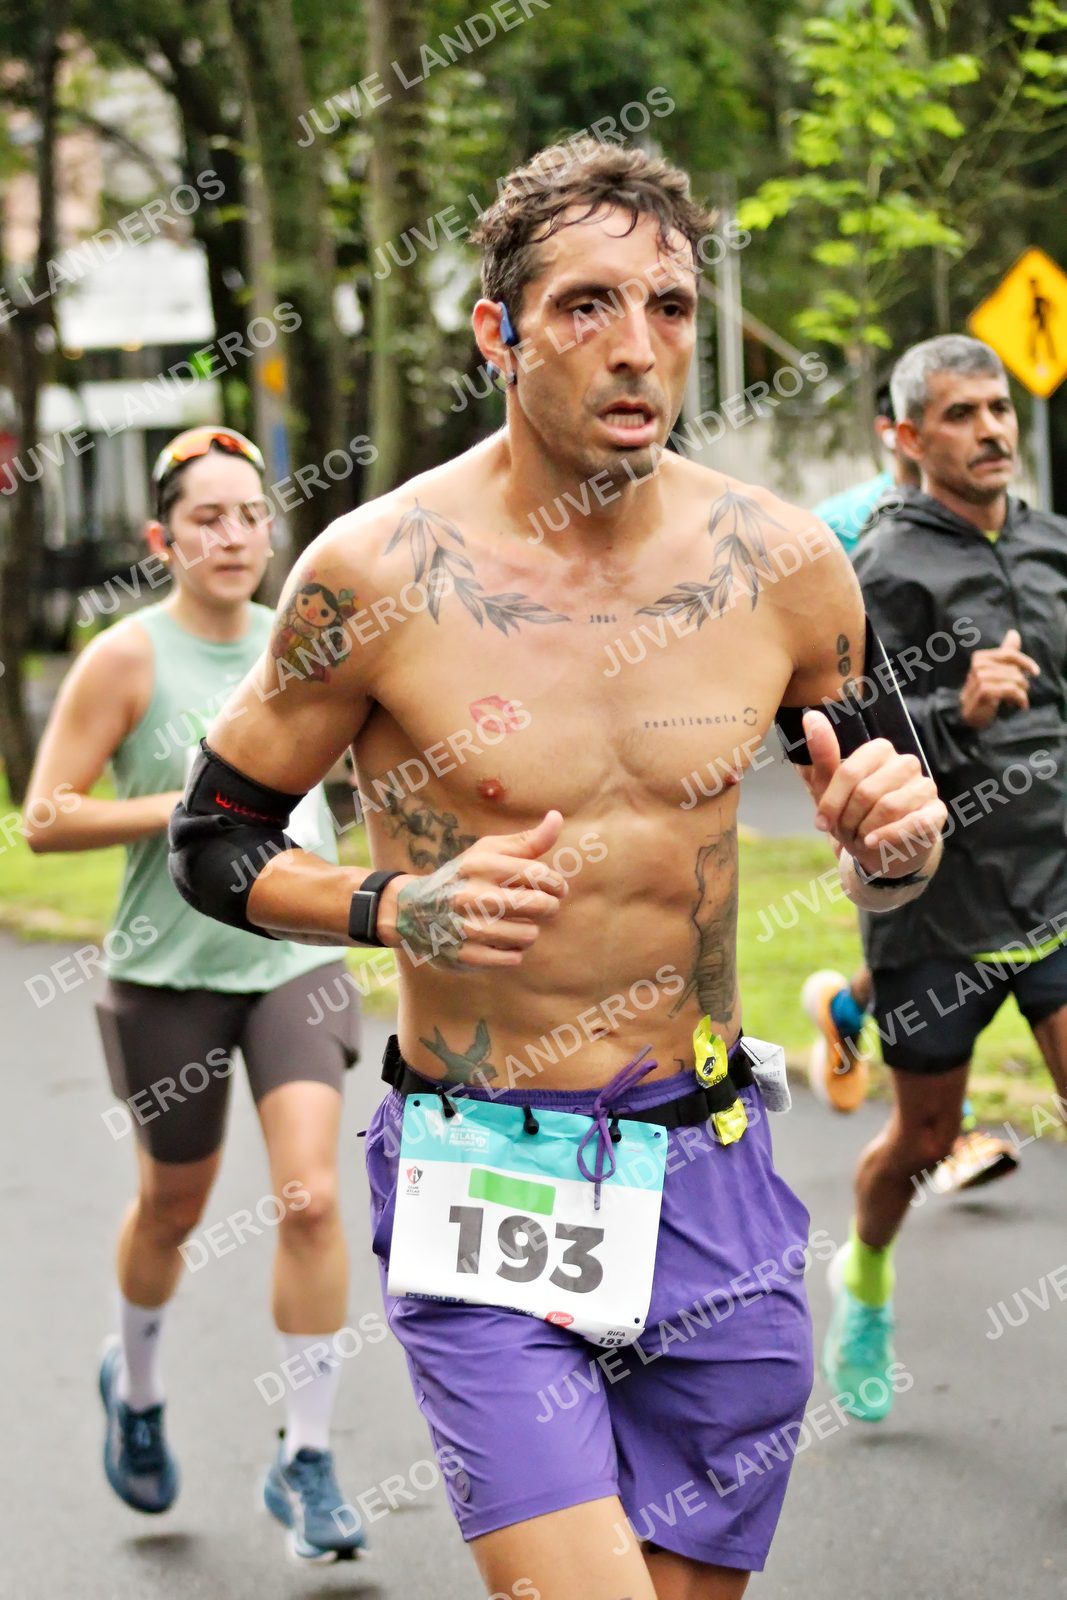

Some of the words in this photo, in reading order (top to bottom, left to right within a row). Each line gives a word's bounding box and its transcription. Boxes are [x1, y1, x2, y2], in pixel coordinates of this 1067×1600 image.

[449, 1205, 605, 1293] 193
[606, 1330, 626, 1338] RIFA
[598, 1337, 625, 1346] 193
